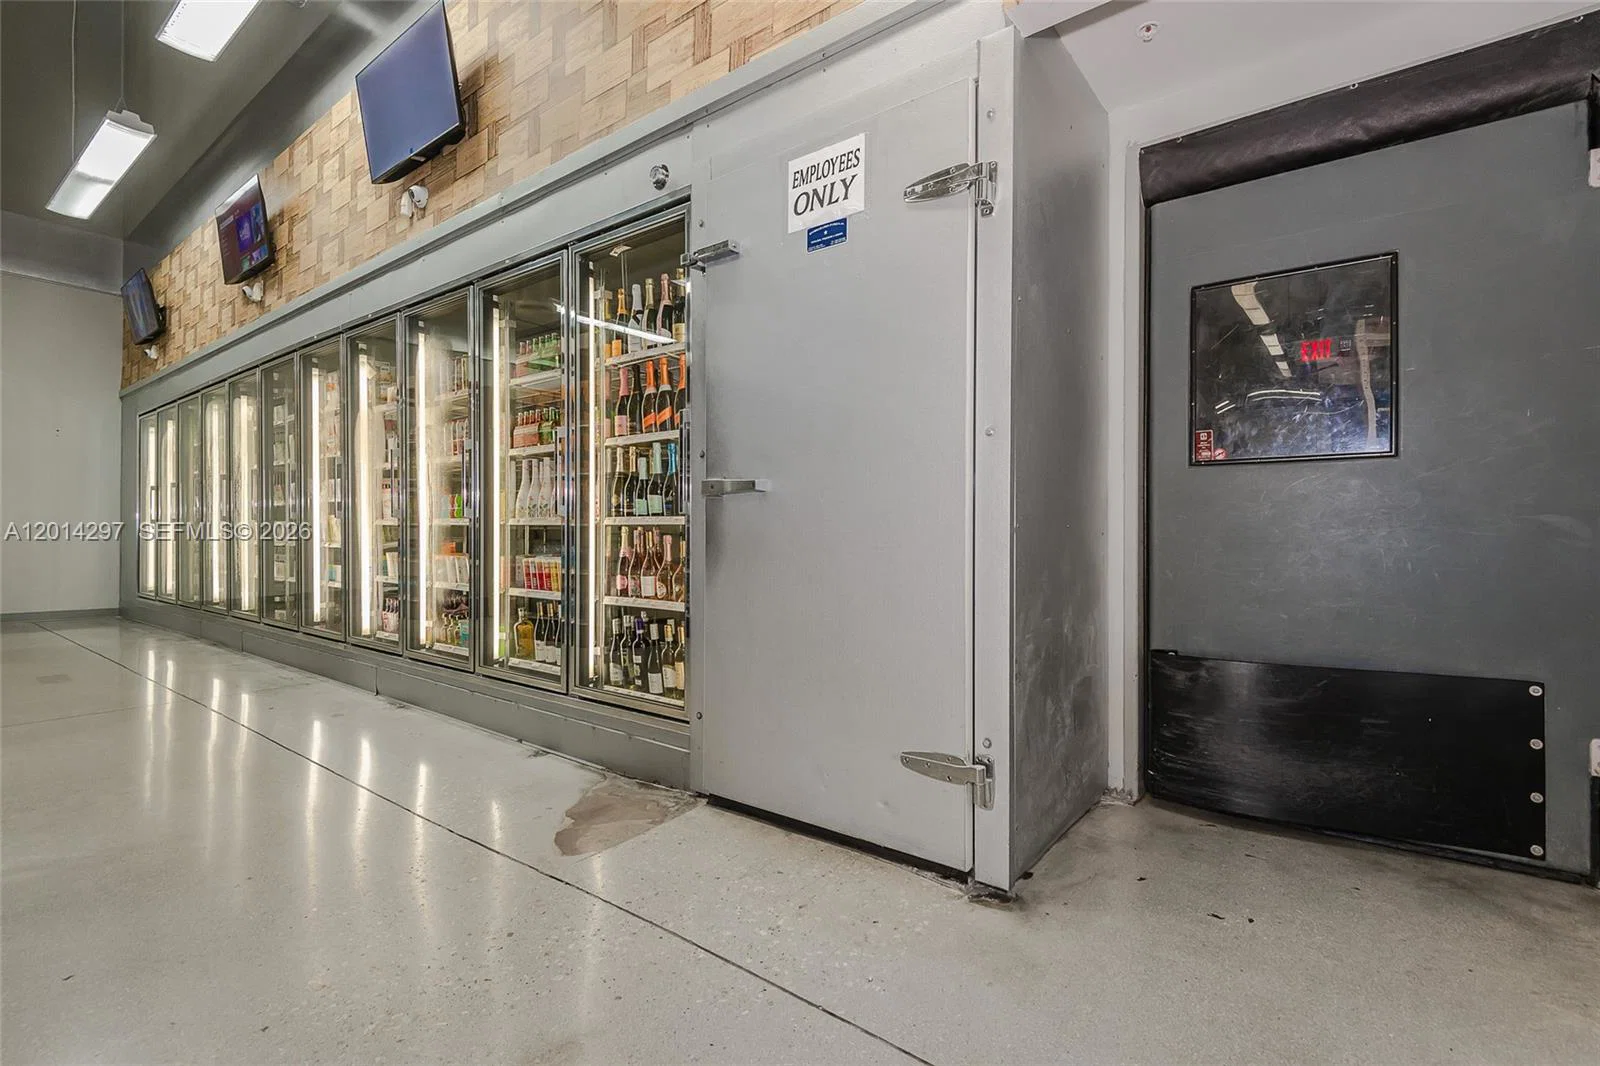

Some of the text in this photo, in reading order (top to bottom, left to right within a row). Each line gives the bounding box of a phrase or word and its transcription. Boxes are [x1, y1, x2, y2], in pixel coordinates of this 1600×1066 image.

[792, 148, 861, 189] EMPLOYEES
[793, 174, 858, 216] ONLY
[1300, 337, 1332, 362] EXIT
